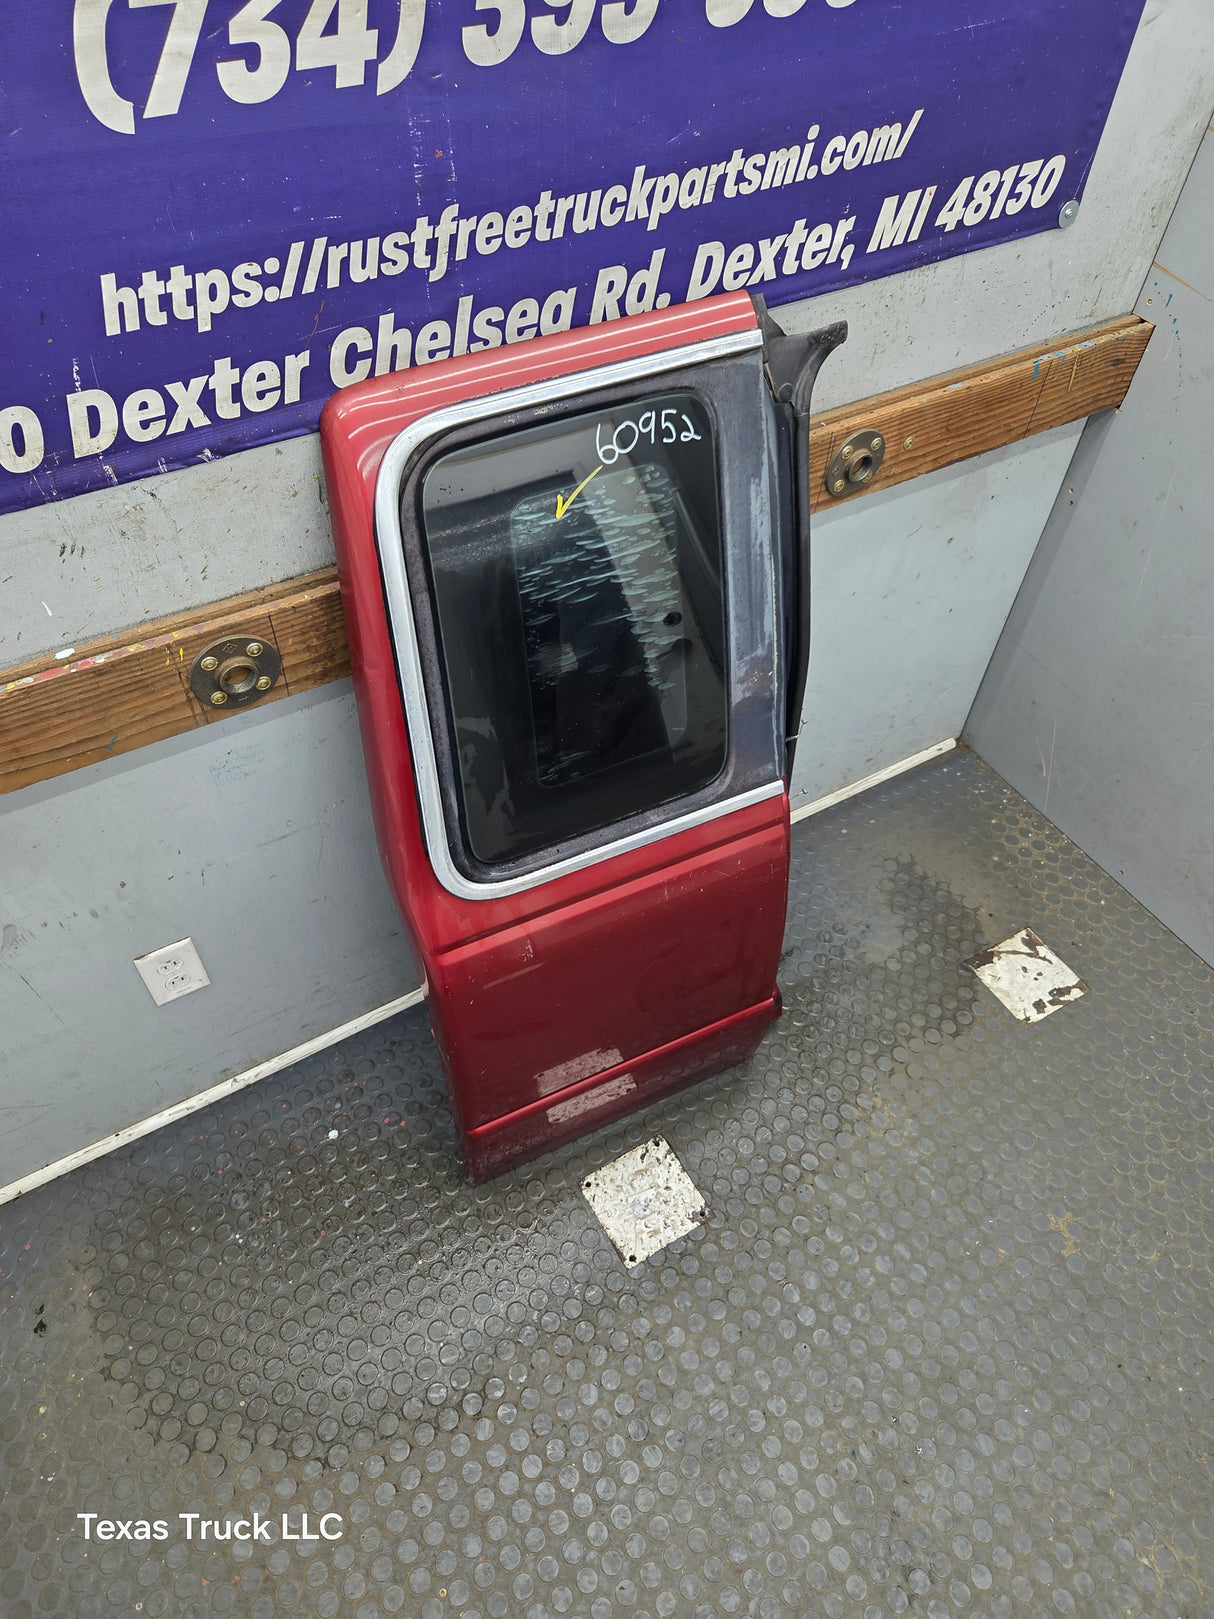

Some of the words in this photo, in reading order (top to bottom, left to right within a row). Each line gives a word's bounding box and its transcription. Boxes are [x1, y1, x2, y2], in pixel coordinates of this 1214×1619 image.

[66, 350, 310, 459] Dexter
[329, 287, 577, 389] Chelsea
[589, 248, 671, 326] Rd.
[686, 215, 856, 302] Dexter,
[866, 185, 937, 253] MI
[935, 154, 1066, 232] 48130
[100, 108, 925, 337] https://rustfreetruckpartsmi.com/
[596, 409, 702, 465] 60952
